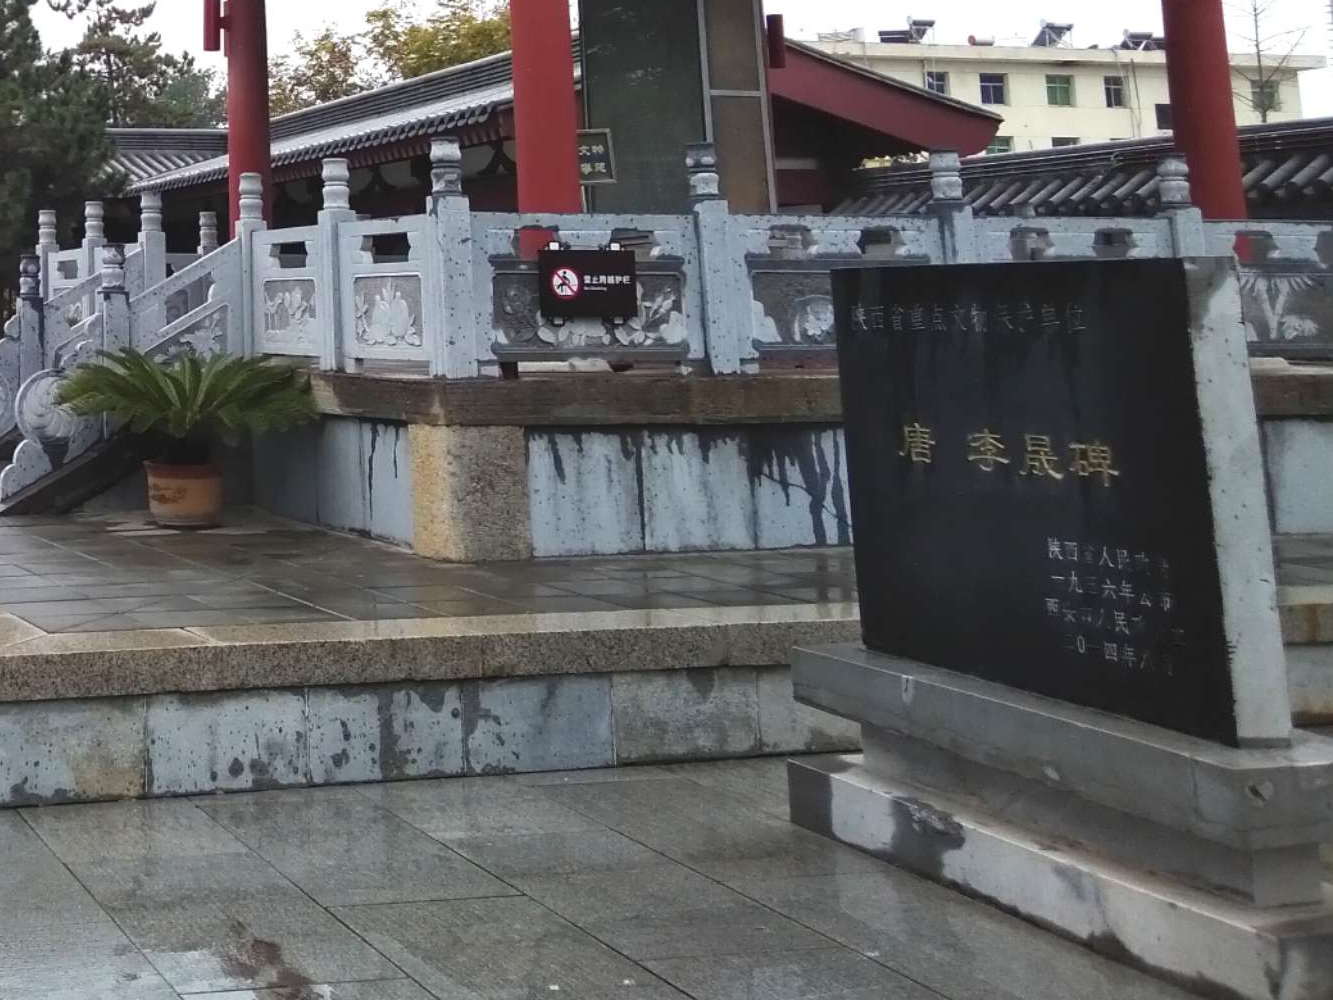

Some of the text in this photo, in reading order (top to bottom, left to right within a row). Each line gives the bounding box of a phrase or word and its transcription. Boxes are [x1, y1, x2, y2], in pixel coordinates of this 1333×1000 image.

[851, 303, 1087, 333] 陕西省重点文物保护单位
[898, 422, 1120, 487] 唐李晟碑
